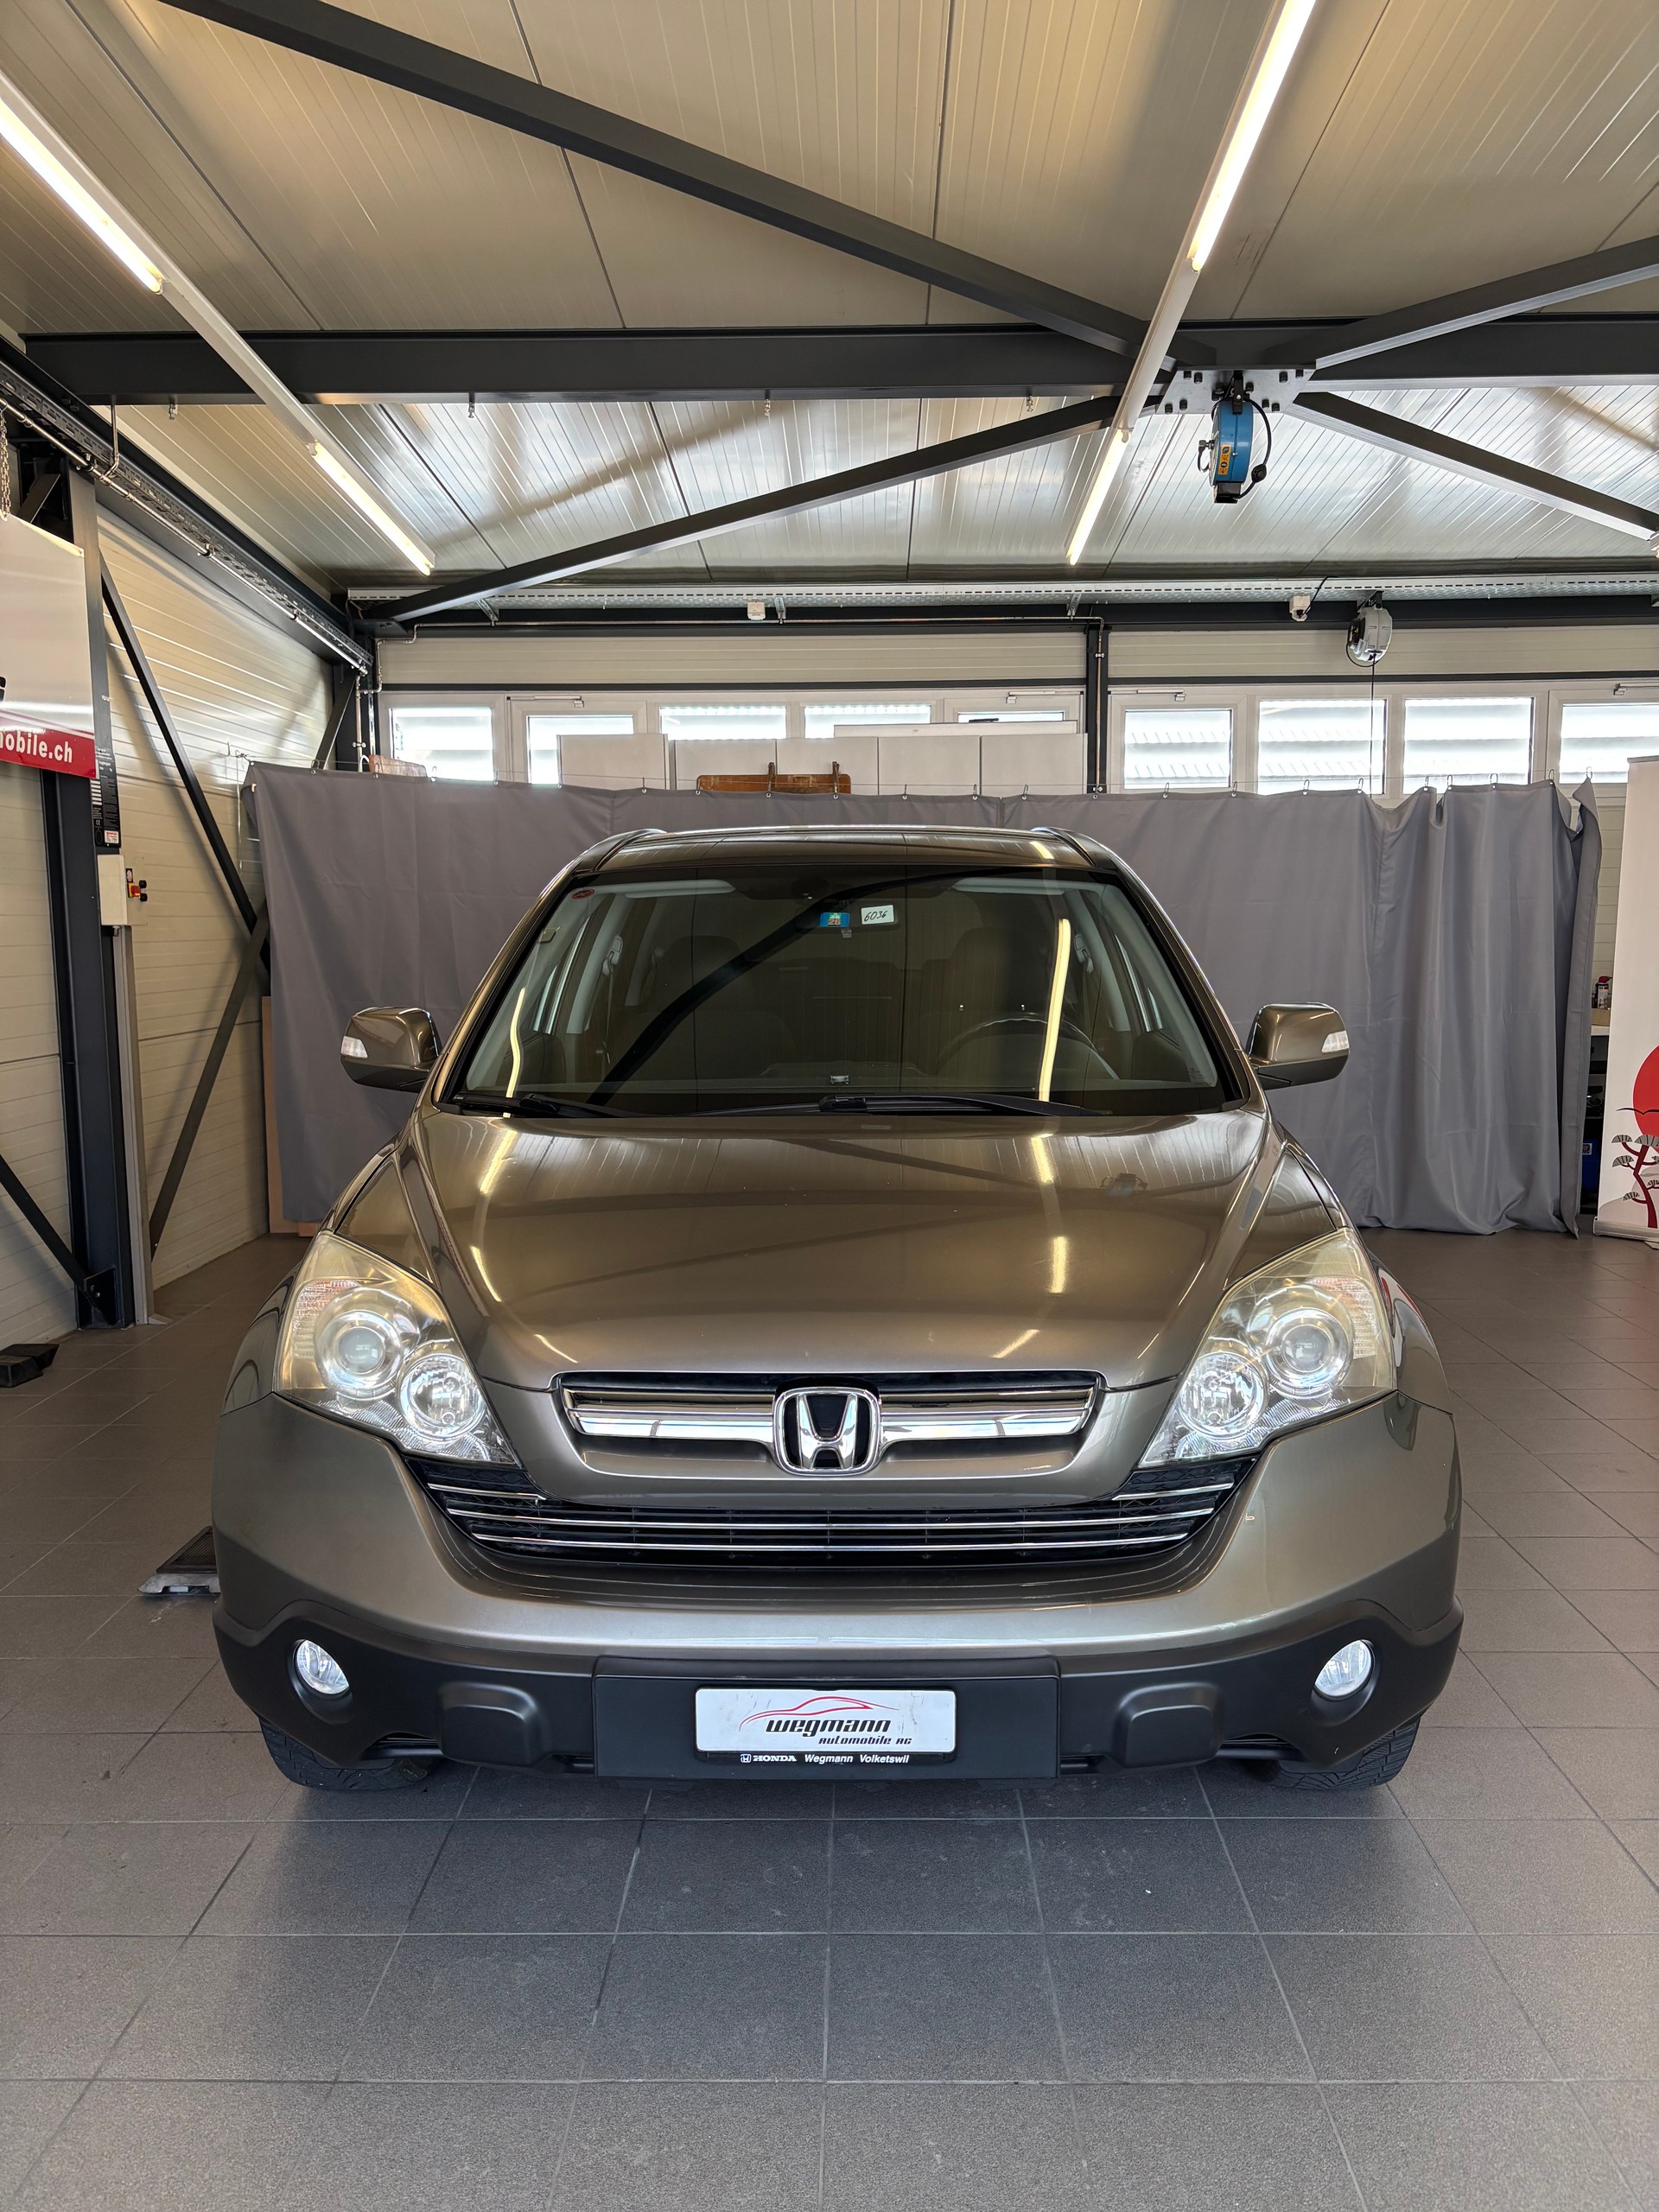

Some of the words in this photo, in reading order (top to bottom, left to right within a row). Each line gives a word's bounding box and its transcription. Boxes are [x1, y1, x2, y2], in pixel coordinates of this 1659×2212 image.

[864, 911, 888, 922] 6036
[766, 1719, 891, 1738] wegmann
[804, 1754, 853, 1764] Wegmann
[860, 1754, 909, 1764] Volketswil
